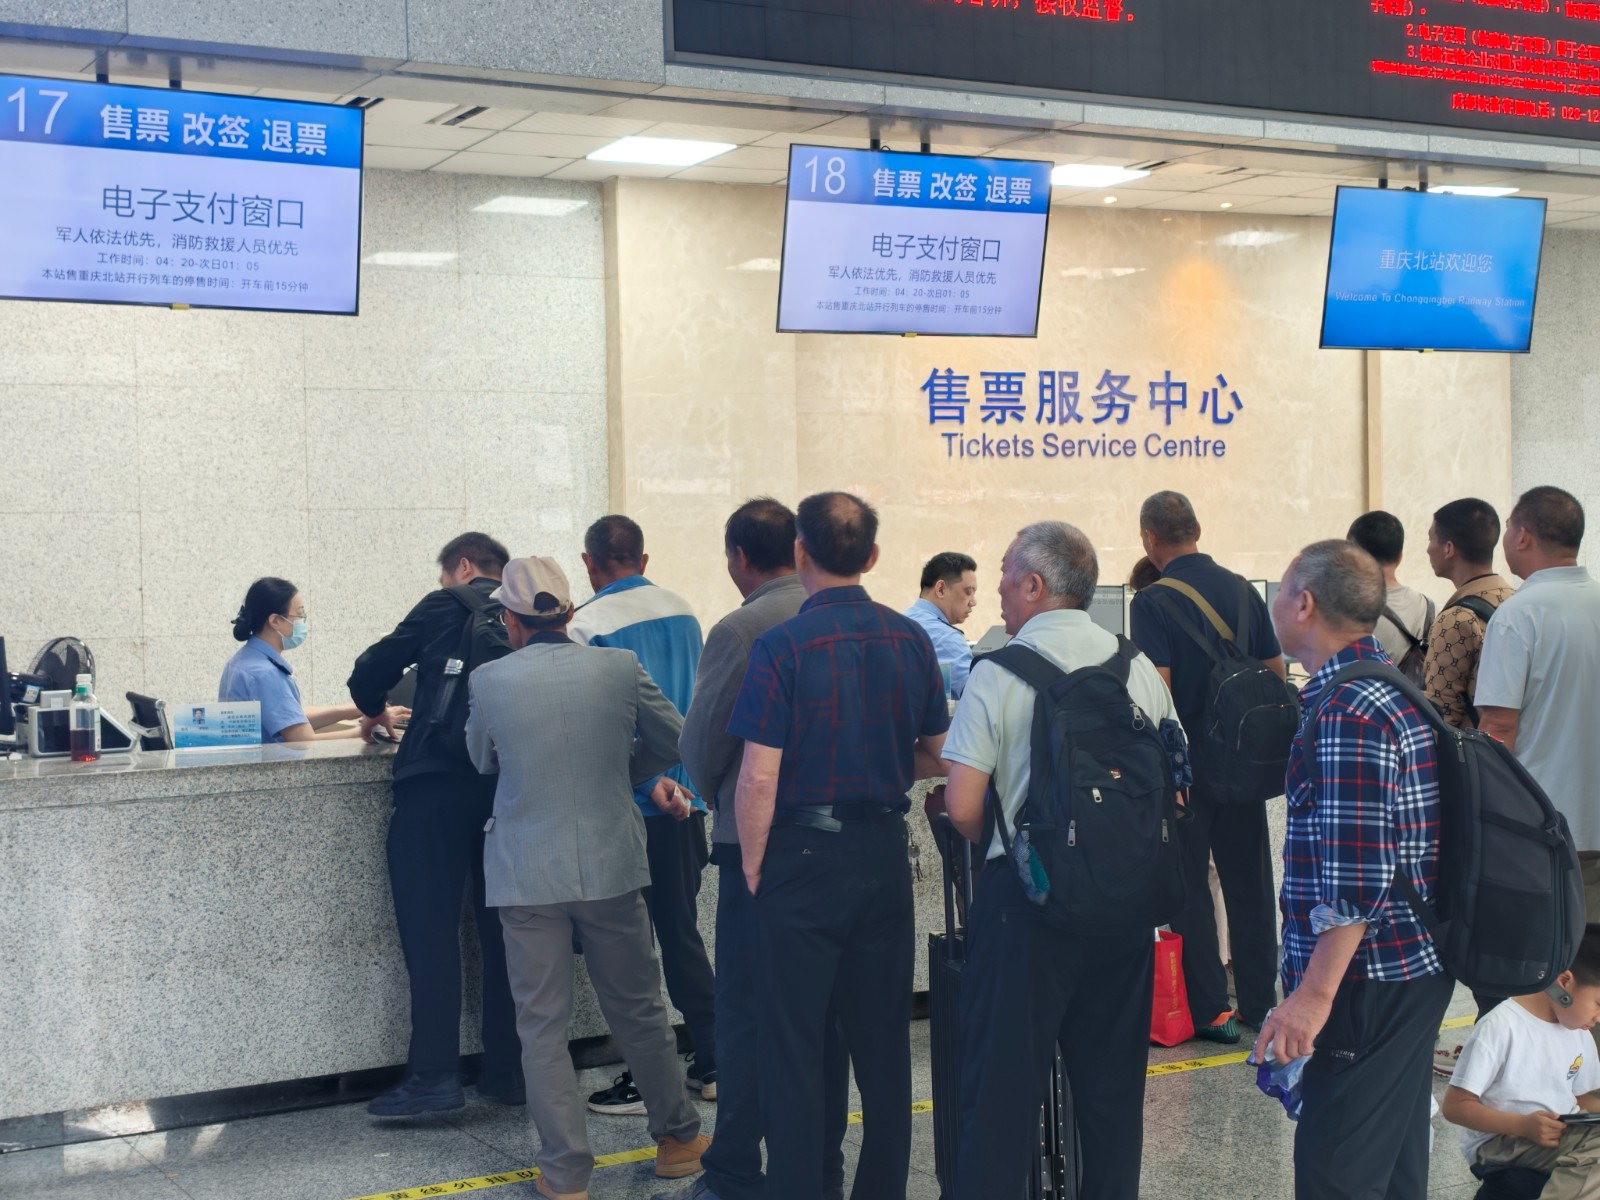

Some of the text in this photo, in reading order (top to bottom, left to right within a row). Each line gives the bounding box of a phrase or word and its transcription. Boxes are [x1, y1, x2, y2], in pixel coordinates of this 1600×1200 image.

[7, 86, 70, 136] 17
[100, 104, 328, 157] 售票 改签 退票
[805, 155, 846, 196] 18
[872, 168, 1033, 206] 售票 改签 退票
[102, 184, 304, 230] 电子支付窗口
[56, 226, 298, 257] 军人依法优先，消防救援人员优先
[872, 232, 1001, 263] 电子支付窗口
[828, 265, 997, 285] 军人依法优先，消防救援人员优先
[1379, 249, 1493, 274] 重庆北站欢迎您
[1335, 291, 1526, 308] Welcome To Chongqingbei Railway Station
[920, 367, 1244, 426] 售票服务中心
[941, 432, 1227, 458] Tickets Service Centre
